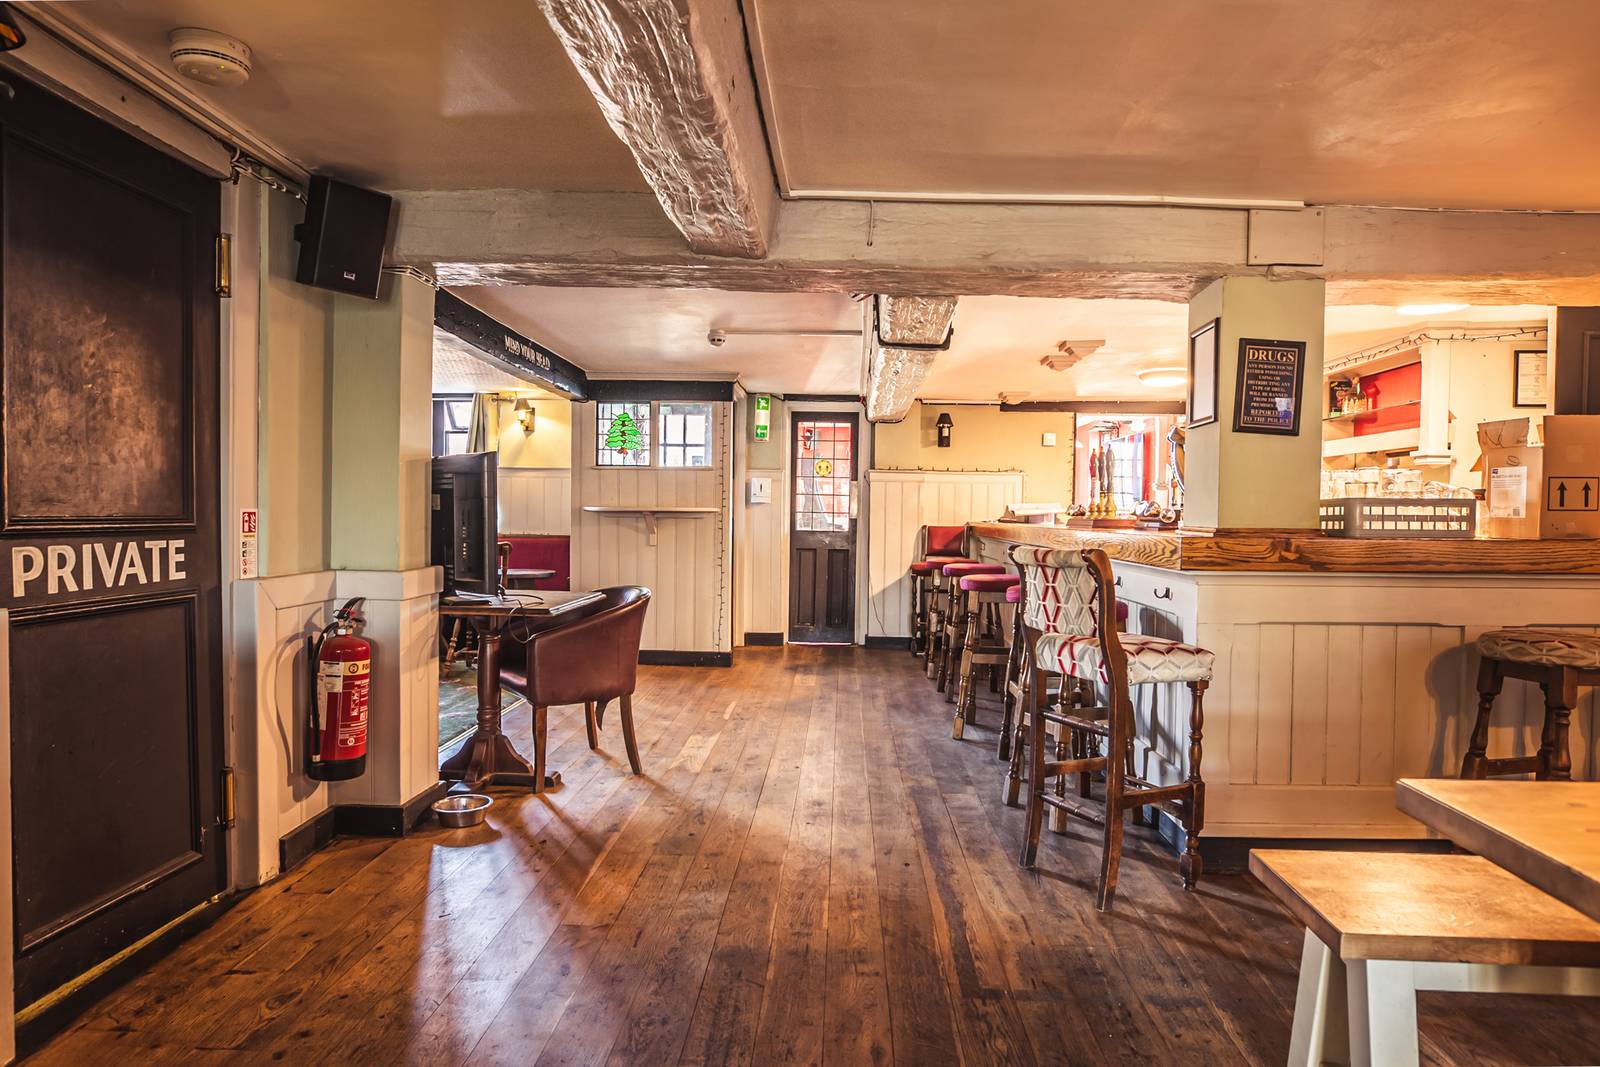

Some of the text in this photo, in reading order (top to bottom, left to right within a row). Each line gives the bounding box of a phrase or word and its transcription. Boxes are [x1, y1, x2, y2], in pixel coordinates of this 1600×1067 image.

[504, 335, 551, 370] MIND YOUR HEAD
[1248, 349, 1295, 362] DRUGS
[12, 539, 187, 598] PRIVATE
